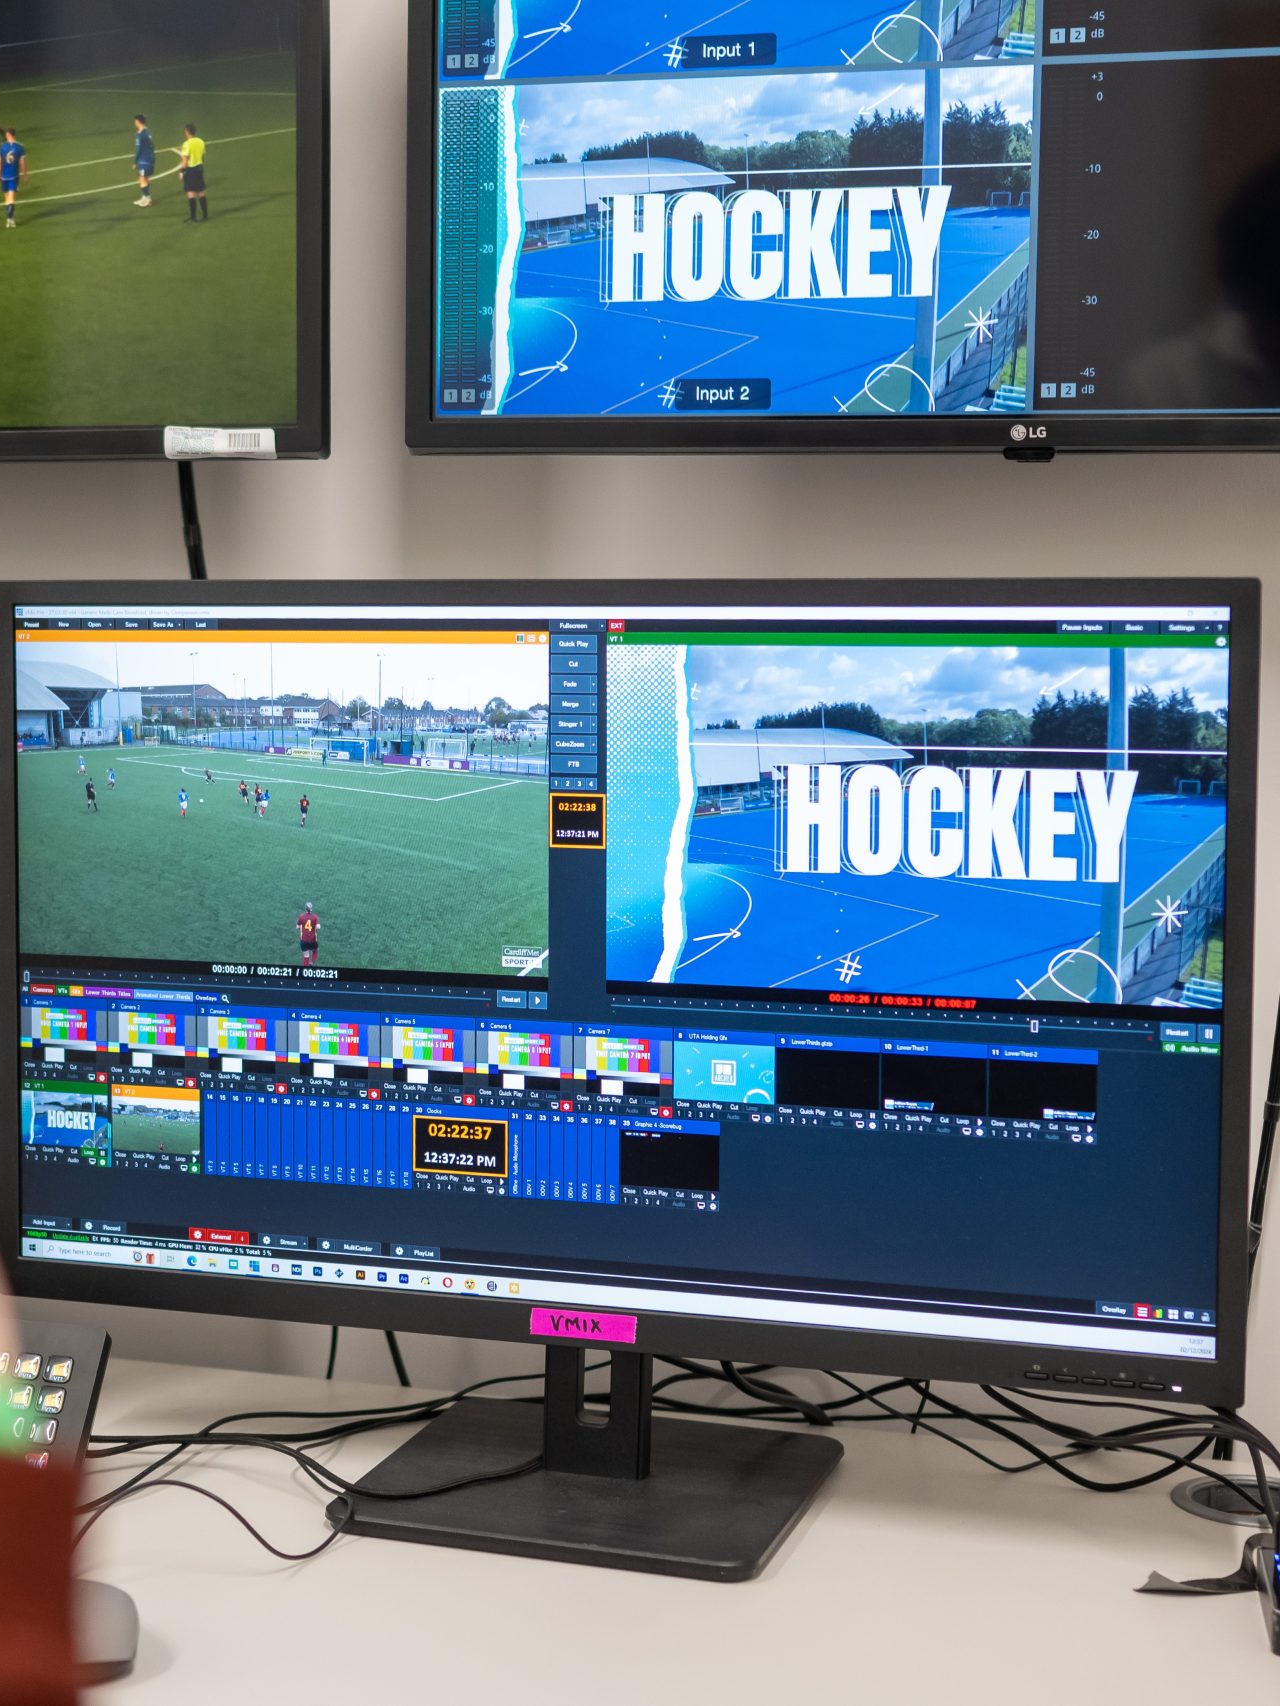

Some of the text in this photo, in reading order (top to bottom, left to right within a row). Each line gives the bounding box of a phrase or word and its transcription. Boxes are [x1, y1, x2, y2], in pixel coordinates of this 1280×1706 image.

[1089, 11, 1105, 20] -45
[1056, 31, 1080, 40] 1 2
[1091, 29, 1104, 38] dB
[482, 38, 495, 47] -45
[703, 42, 755, 60] Input 1
[483, 55, 495, 64] dB
[1091, 72, 1103, 81] +3
[1097, 92, 1103, 101] 0
[6, 151, 14, 164] 6
[1085, 164, 1101, 174] -10
[480, 183, 494, 192] -10
[1083, 230, 1099, 240] -20
[600, 185, 952, 302] HOCKEY
[479, 245, 494, 253] -20
[1081, 296, 1098, 305] -30
[478, 307, 493, 316] -30
[1080, 368, 1095, 376] -45
[478, 375, 492, 383] -45
[1046, 386, 1071, 395] 1 2
[1081, 385, 1095, 394] dB
[696, 386, 749, 403] Input 2
[1029, 427, 1047, 438] LG
[559, 803, 596, 811] 02:22:38
[773, 763, 1139, 883] HOCKEY
[556, 830, 585, 838] 12:37:21
[305, 920, 312, 932] 4
[212, 964, 338, 979] 00:00:00 00:02:21 00:02:21
[32, 986, 54, 994] Cameras
[102, 989, 116, 997] Thirds
[195, 994, 217, 1002] Overlays
[881, 996, 923, 1007] 00:00:33
[395, 1017, 410, 1025] Camera
[490, 1022, 507, 1030] Camera
[588, 1027, 605, 1035] Camera
[700, 1034, 718, 1042] Holding
[47, 1110, 97, 1131] HOCKEY
[634, 1121, 650, 1130] Graphic
[428, 1123, 492, 1140] 02:22:37
[424, 1152, 496, 1167] 12:37:22 PM
[44, 1219, 56, 1227] Input
[344, 1244, 373, 1252] MultiCorder
[1102, 1305, 1126, 1315] Overlay
[551, 1315, 602, 1333] VMIX
